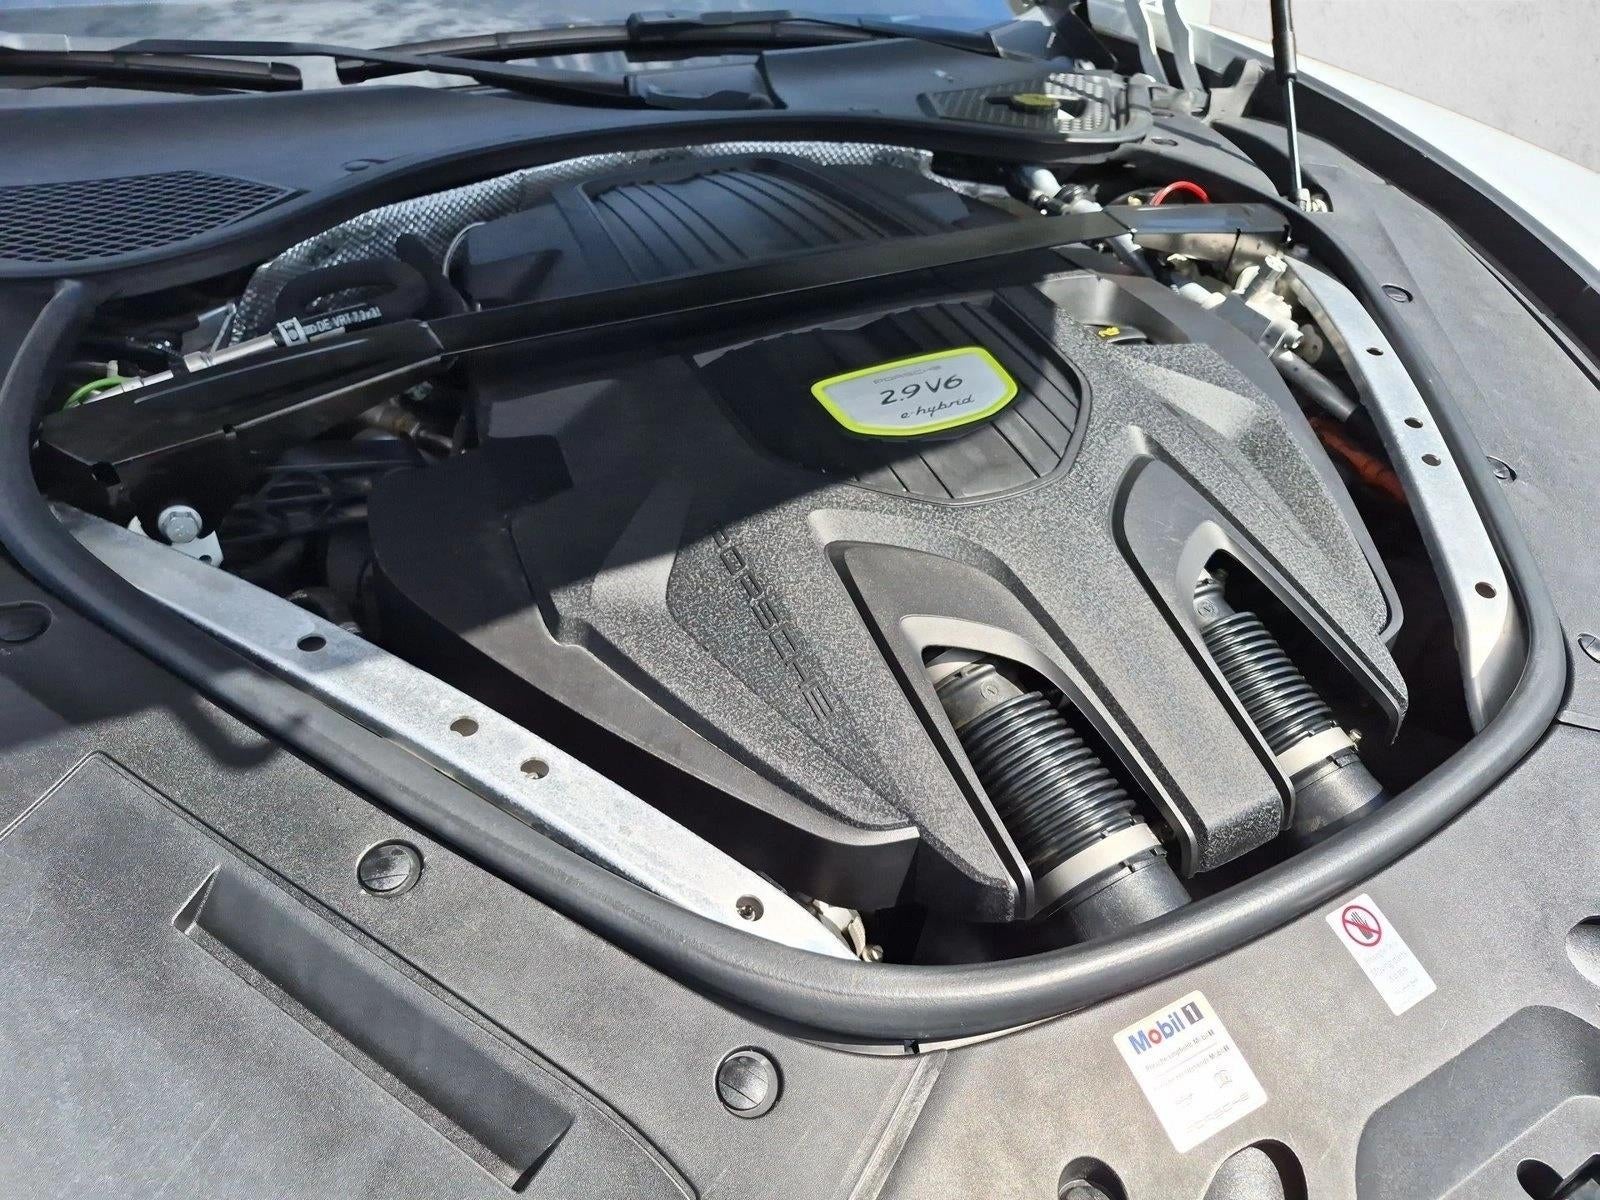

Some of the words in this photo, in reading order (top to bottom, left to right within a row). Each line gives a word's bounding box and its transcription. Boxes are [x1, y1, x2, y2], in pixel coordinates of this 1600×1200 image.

[879, 383, 921, 406] 2.9
[926, 374, 964, 394] V6
[900, 394, 975, 419] e-hybrid
[1128, 1011, 1186, 1055] Mobil
[1183, 1002, 1203, 1024] 1
